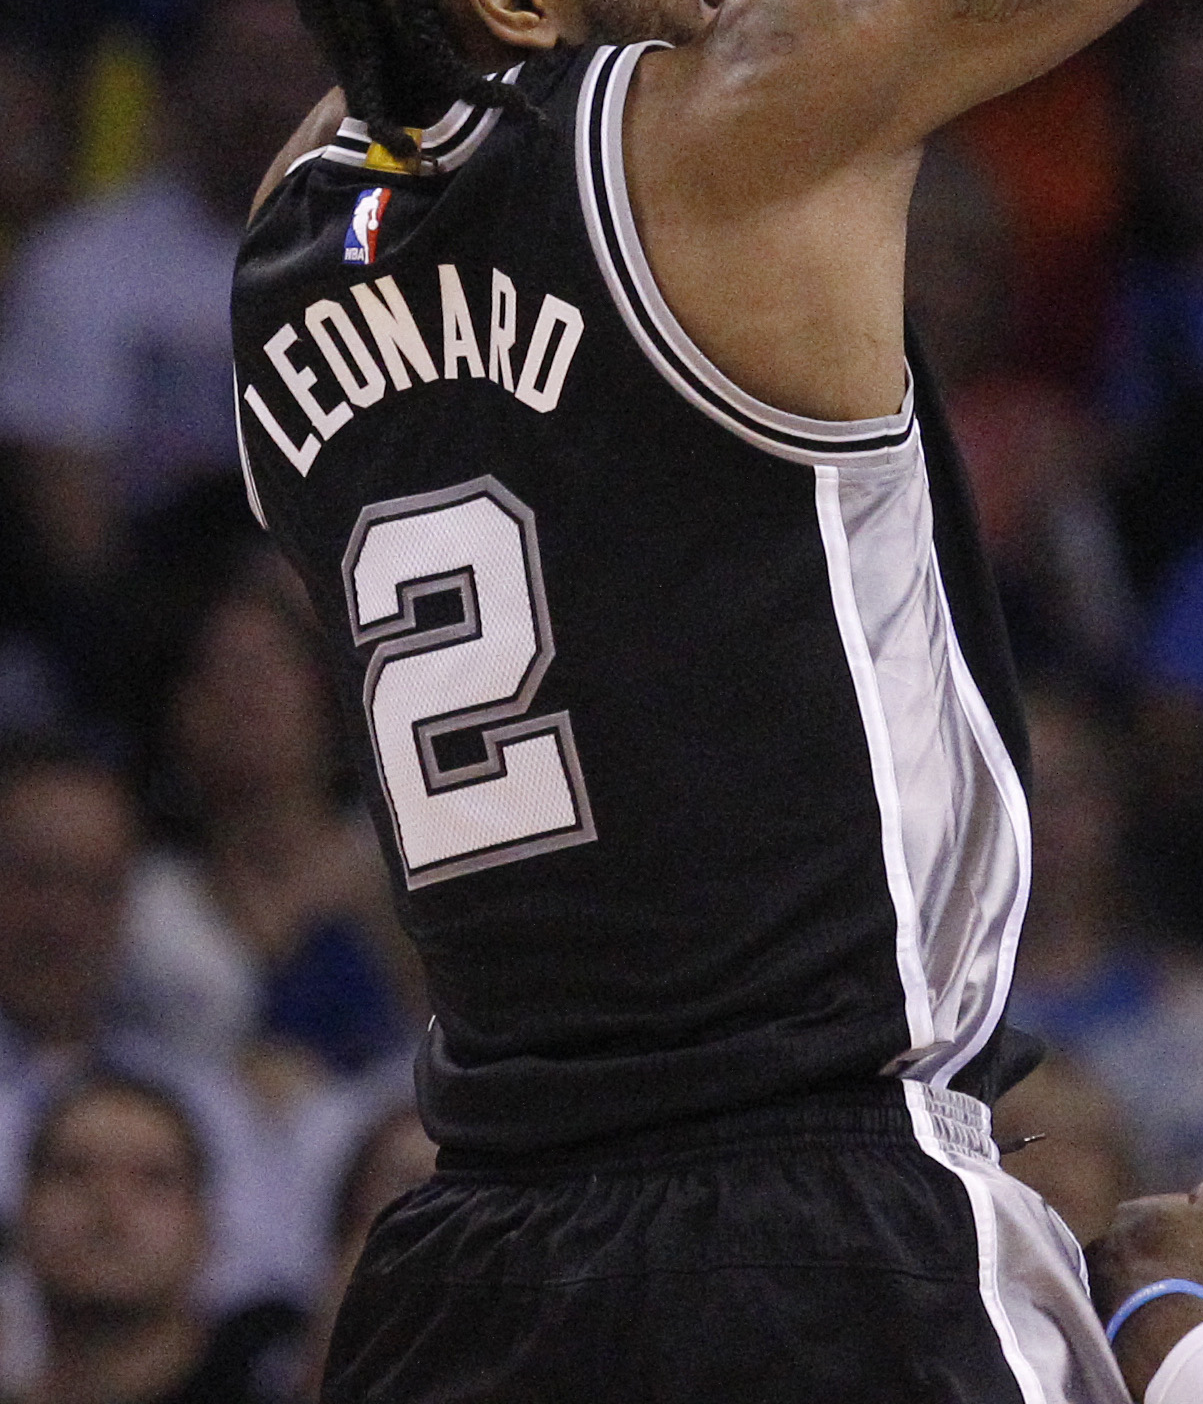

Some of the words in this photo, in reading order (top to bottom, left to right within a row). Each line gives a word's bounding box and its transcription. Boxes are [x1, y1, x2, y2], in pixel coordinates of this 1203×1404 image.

[344, 247, 365, 261] NBA
[244, 264, 584, 477] LEONARD
[341, 474, 598, 891] 2
